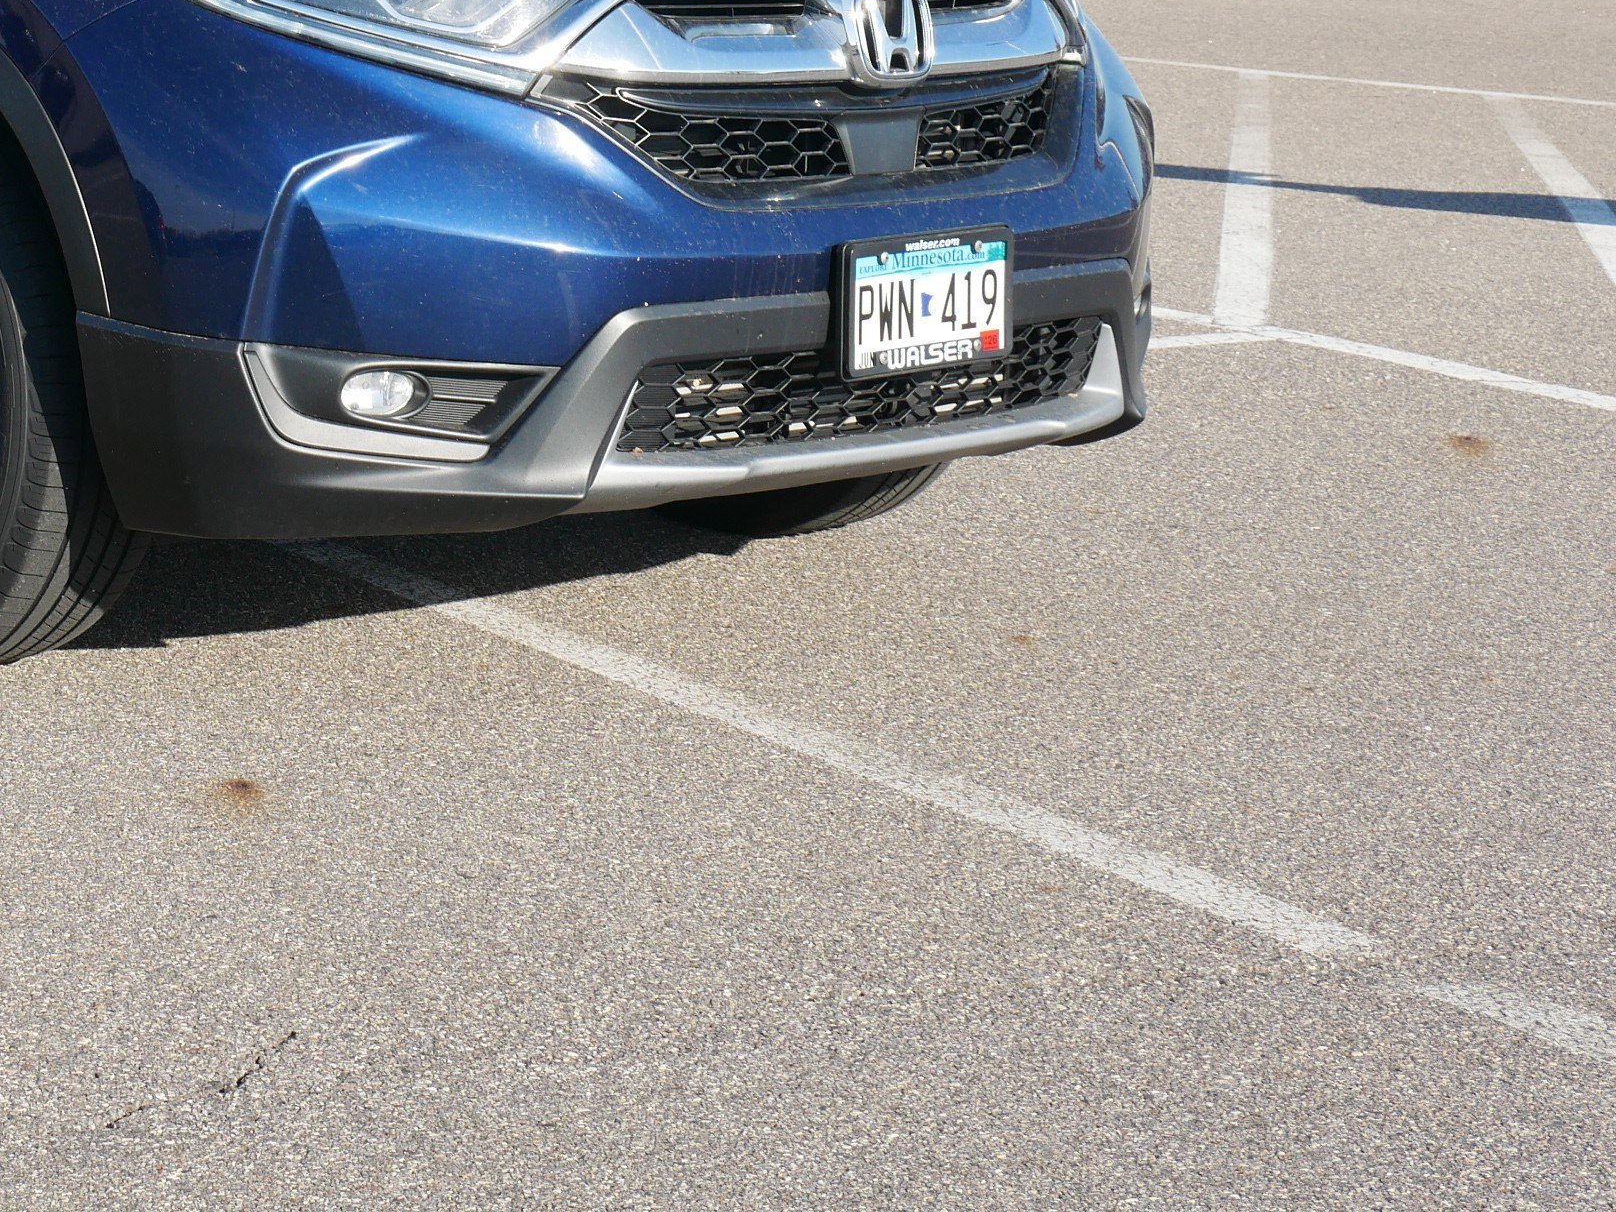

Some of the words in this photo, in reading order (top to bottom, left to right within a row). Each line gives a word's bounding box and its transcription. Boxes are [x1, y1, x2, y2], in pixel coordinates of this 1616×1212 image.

[905, 237, 961, 252] walser.com
[858, 278, 915, 346] PWN
[941, 268, 998, 332] 419
[886, 338, 974, 370] WALSER
